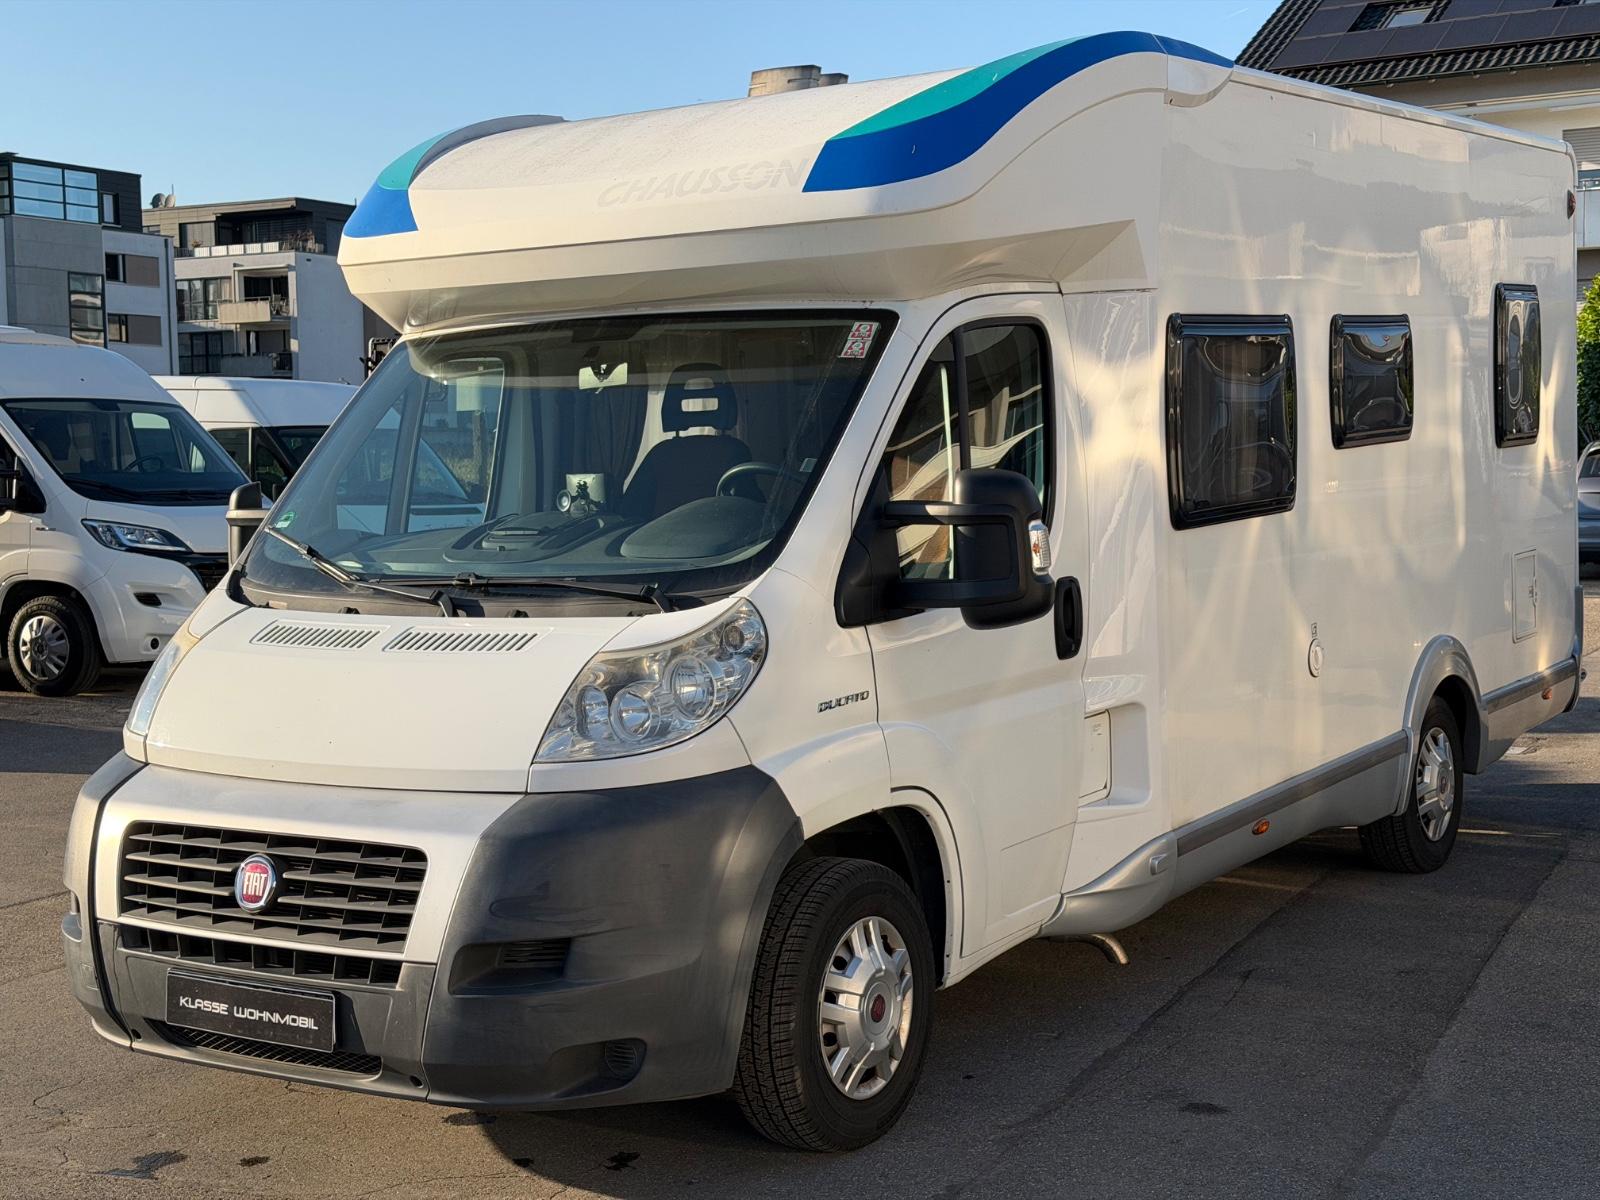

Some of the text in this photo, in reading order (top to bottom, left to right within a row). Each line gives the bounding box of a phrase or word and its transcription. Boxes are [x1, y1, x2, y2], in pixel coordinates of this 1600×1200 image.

[598, 158, 809, 207] CHAUSSON
[817, 690, 869, 713] DUCATO
[243, 871, 268, 897] FIAT
[179, 995, 319, 1030] KLASSE WOHNMOBIL
